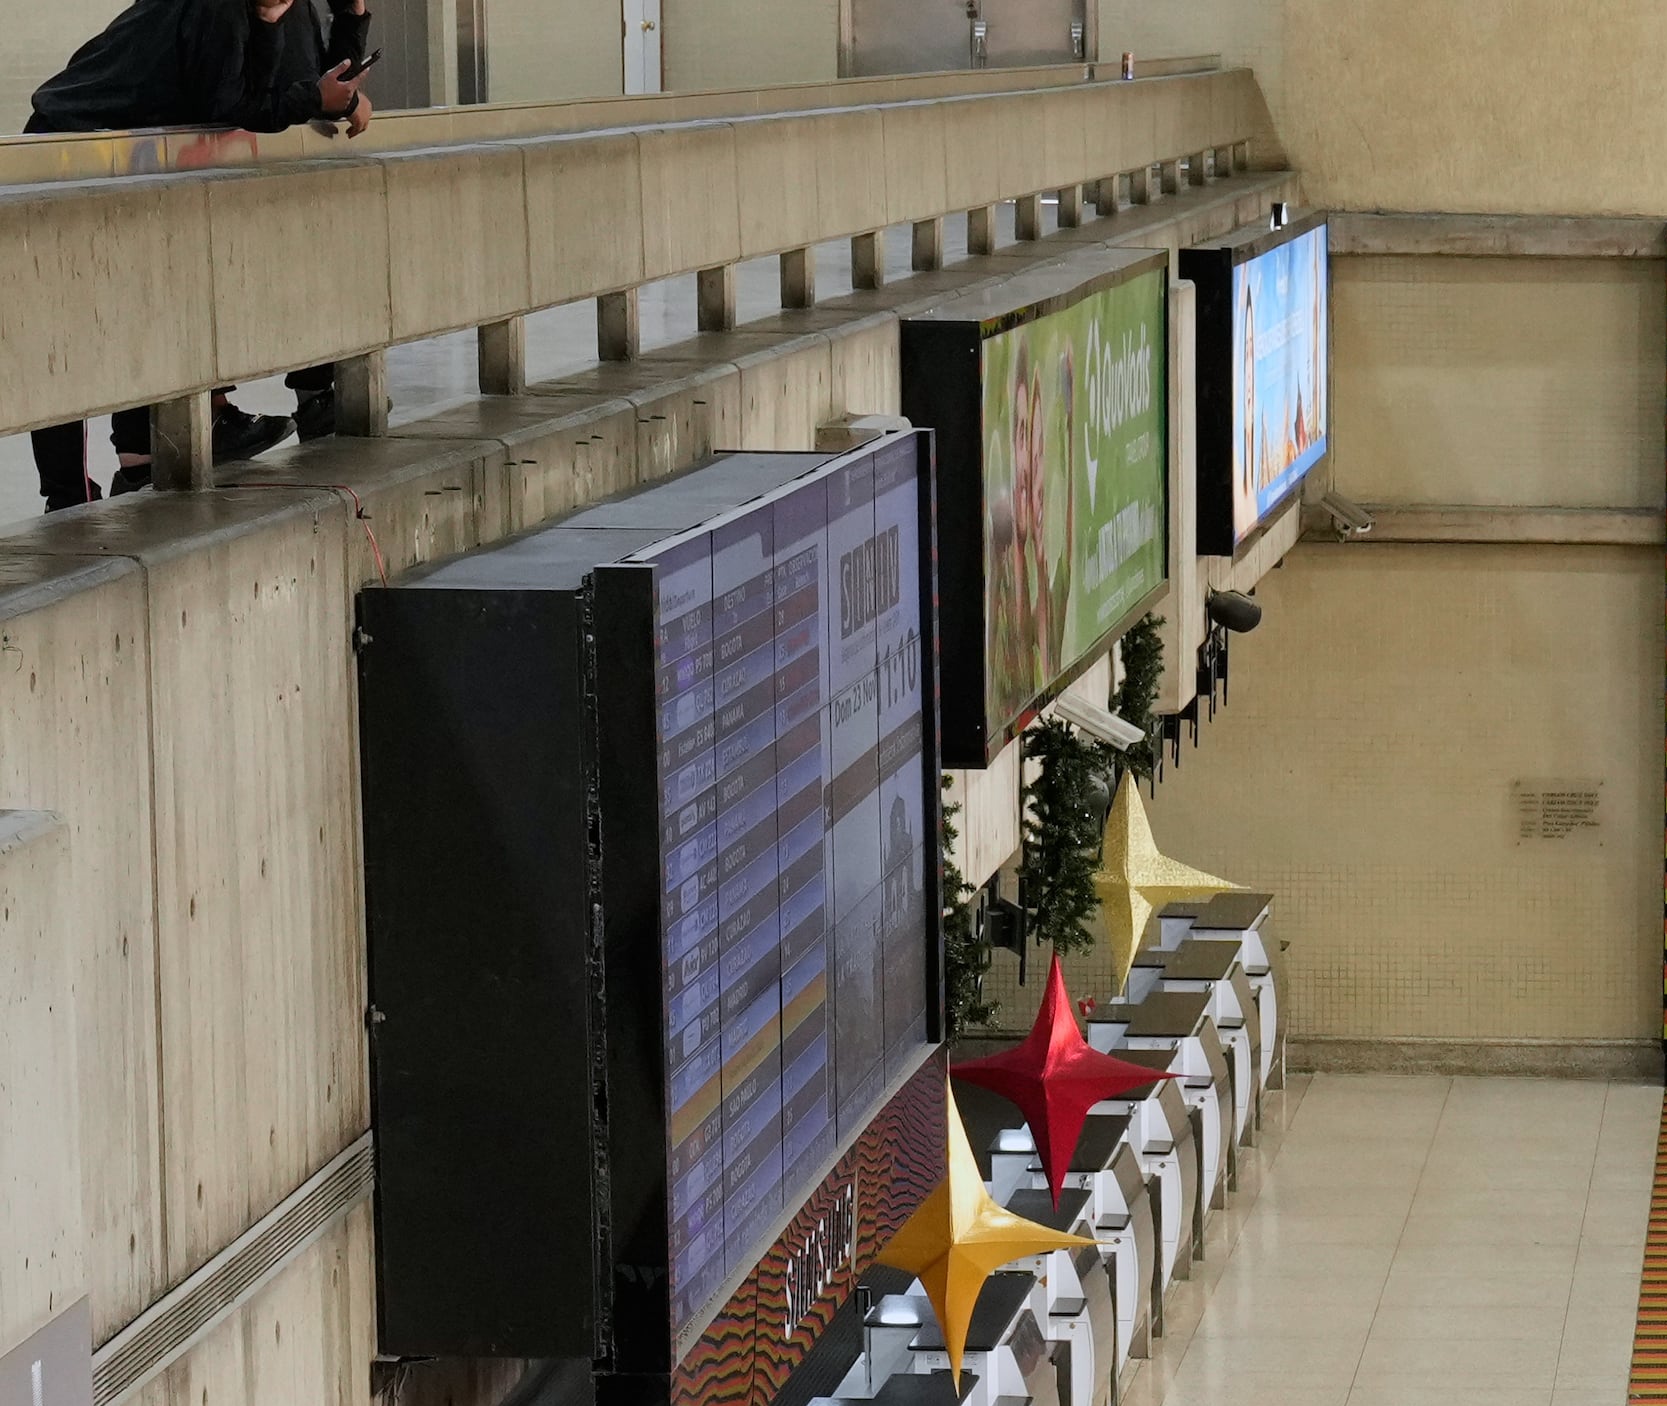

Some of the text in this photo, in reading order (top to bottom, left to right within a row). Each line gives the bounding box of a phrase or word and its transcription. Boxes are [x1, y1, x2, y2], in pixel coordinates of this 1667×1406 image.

[835, 673, 877, 728] Dom 23 Nov
[876, 627, 916, 716] 11:10
